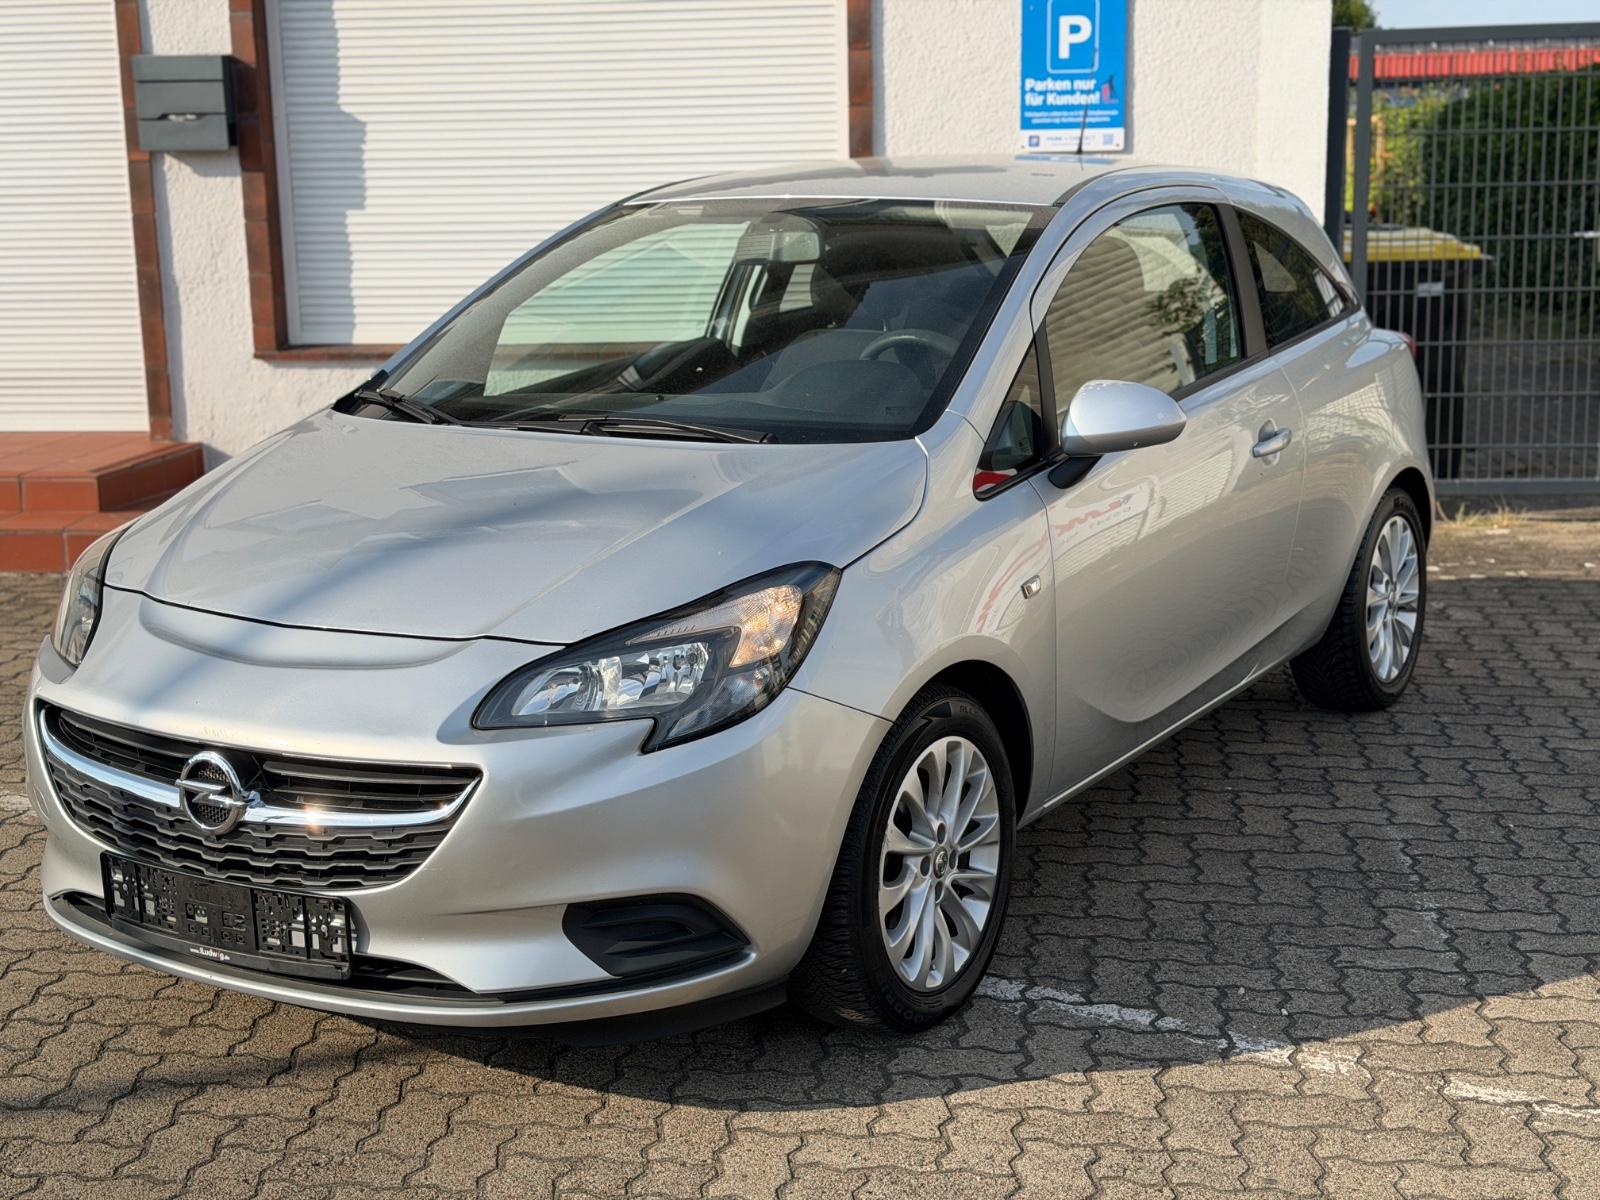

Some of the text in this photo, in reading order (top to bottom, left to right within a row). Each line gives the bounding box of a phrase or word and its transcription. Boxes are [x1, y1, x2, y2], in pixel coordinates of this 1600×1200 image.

[1058, 14, 1092, 60] P
[1025, 78, 1097, 92] Parken nur
[1025, 91, 1101, 106] für Kunden!
